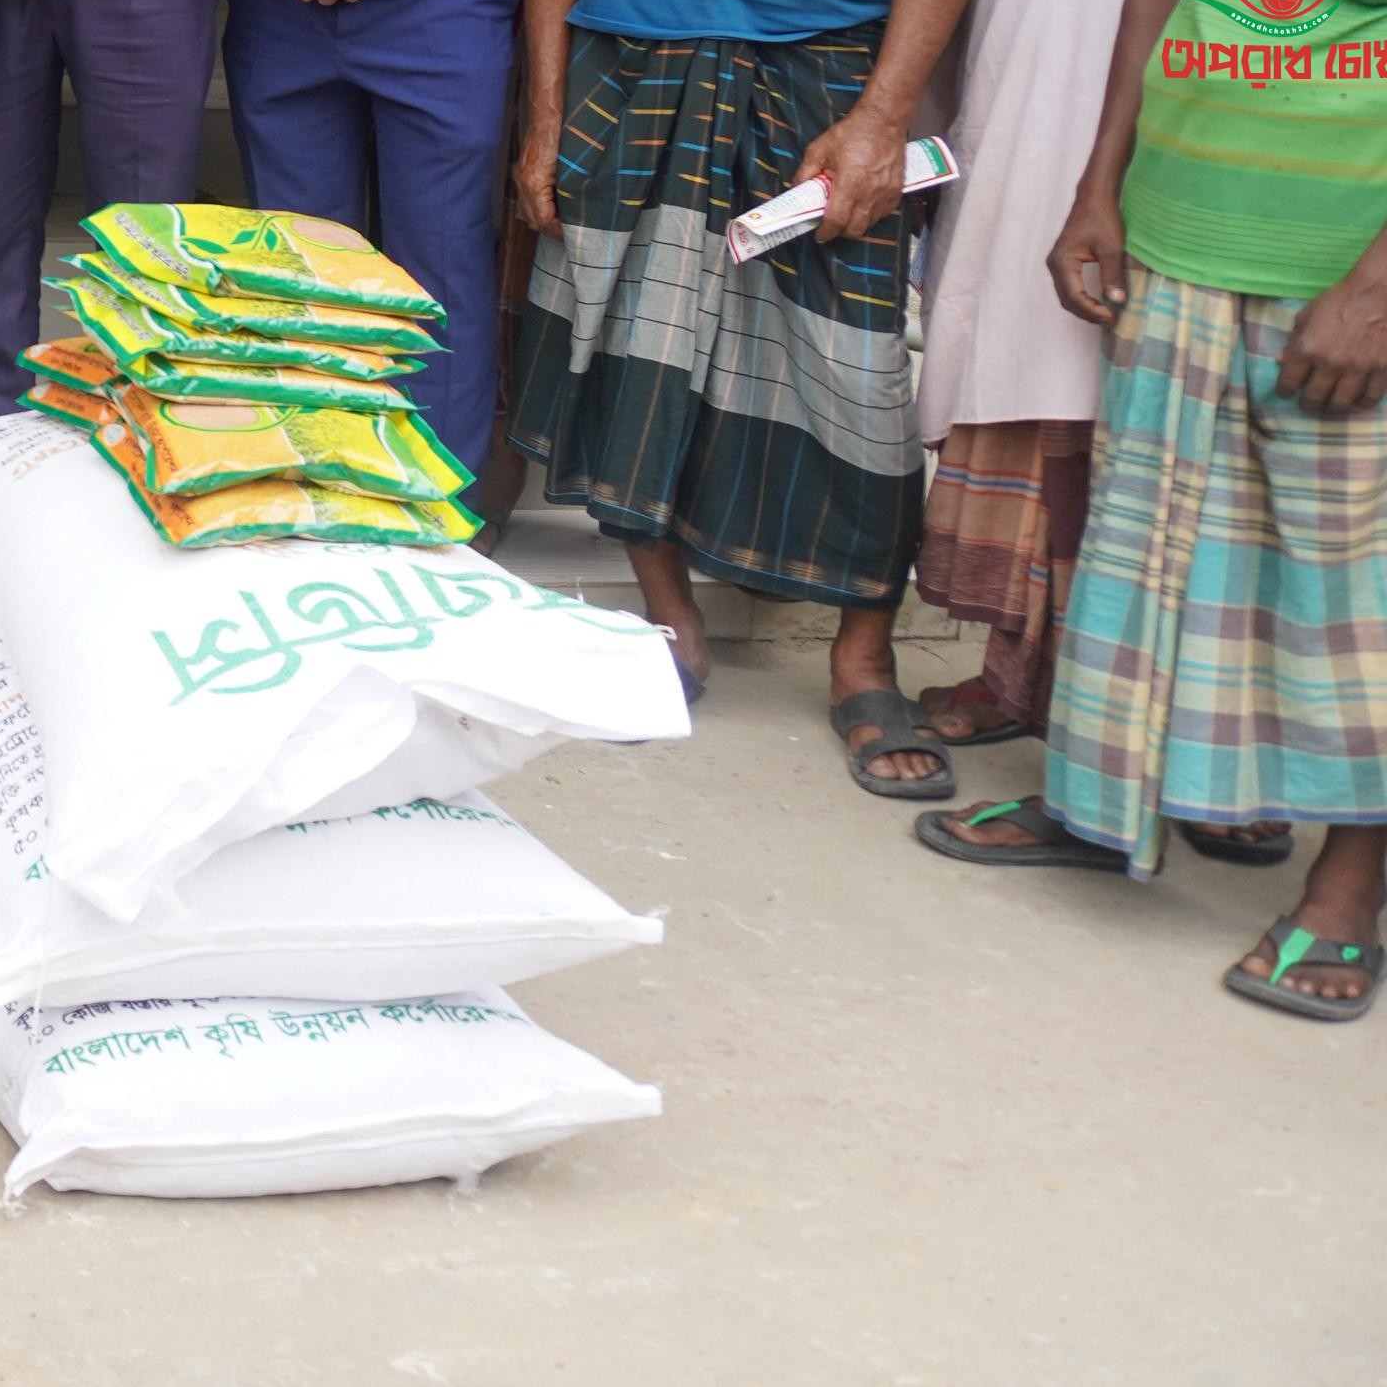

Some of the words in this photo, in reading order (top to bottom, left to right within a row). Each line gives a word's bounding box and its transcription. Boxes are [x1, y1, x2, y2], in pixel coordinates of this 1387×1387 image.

[41, 1023, 189, 1078] বাংলাদেশ
[203, 1012, 266, 1060] কৃষি
[268, 1005, 370, 1043] উন্নয়ন
